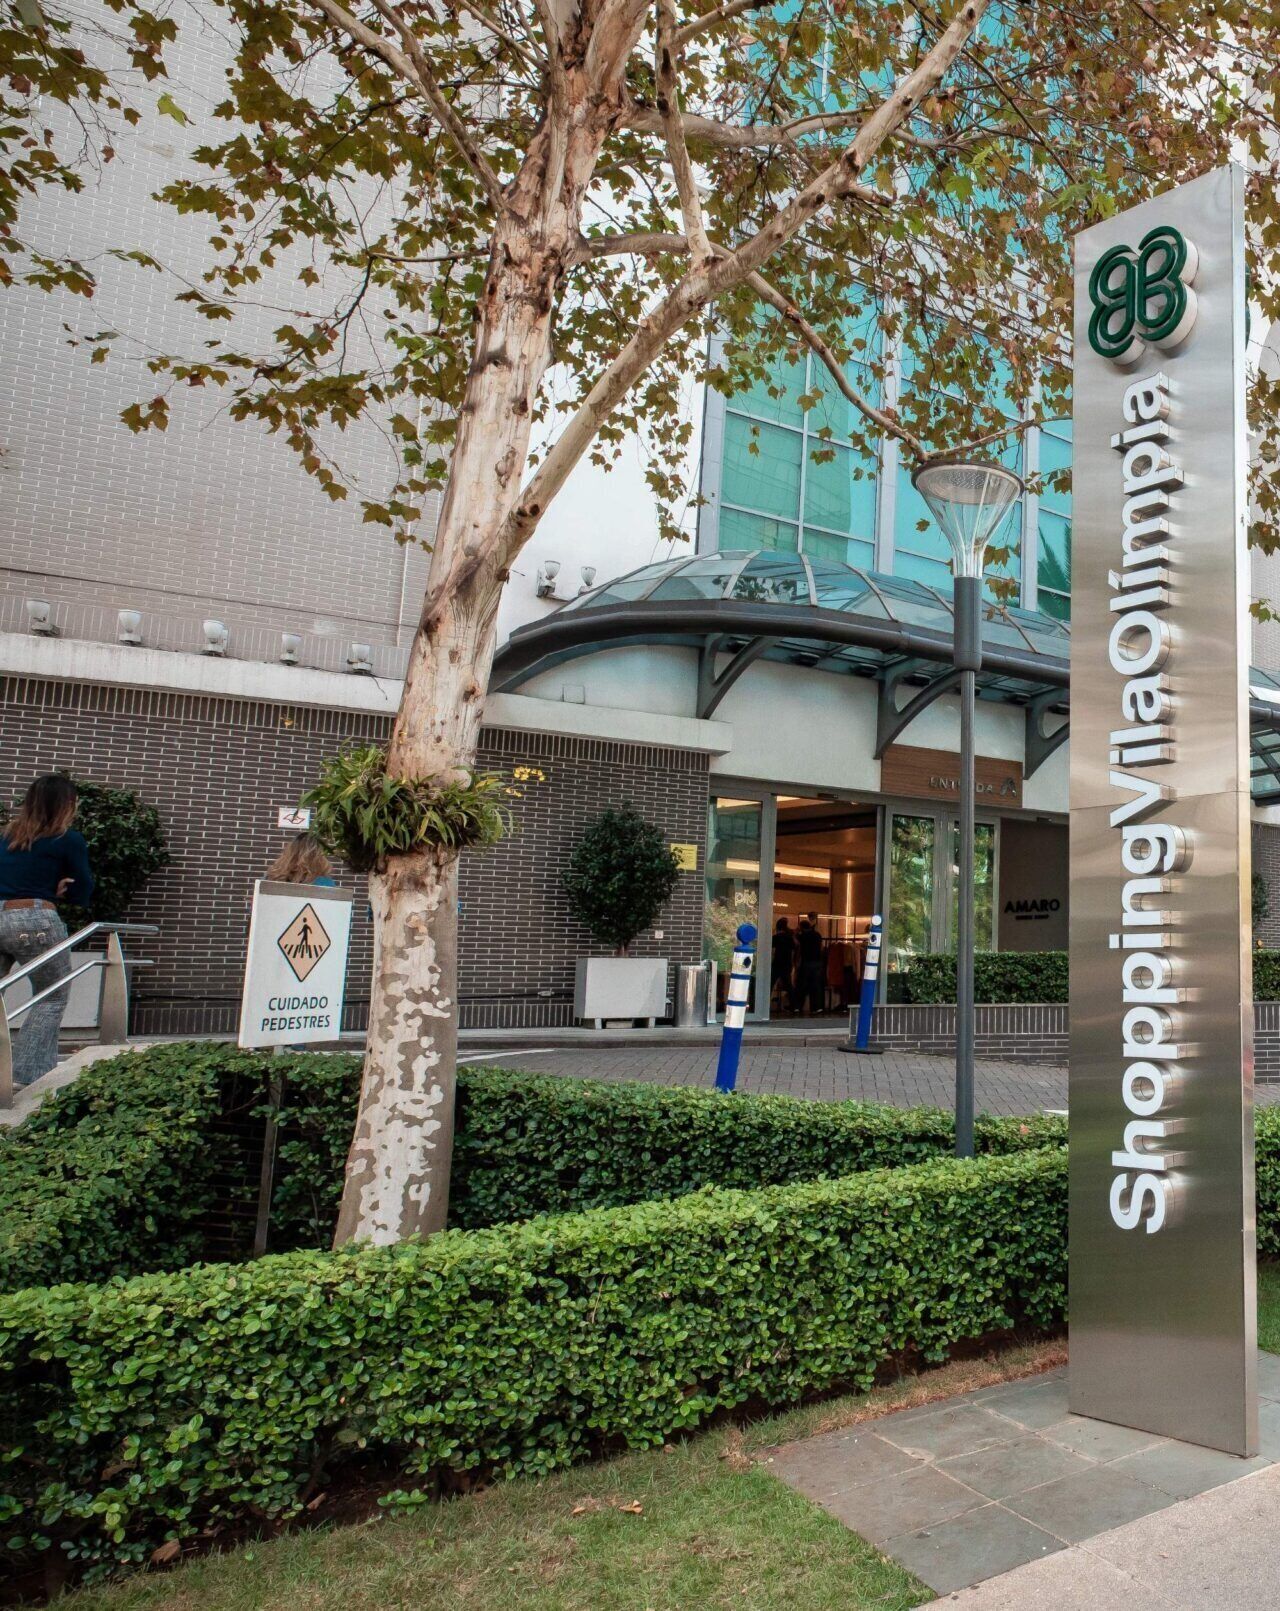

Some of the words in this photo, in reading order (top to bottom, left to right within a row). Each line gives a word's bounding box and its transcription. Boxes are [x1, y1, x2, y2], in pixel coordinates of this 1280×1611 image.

[1004, 899, 1060, 913] AMARO
[268, 996, 329, 1011] CUIDADO
[261, 1015, 331, 1032] PEDESTRES
